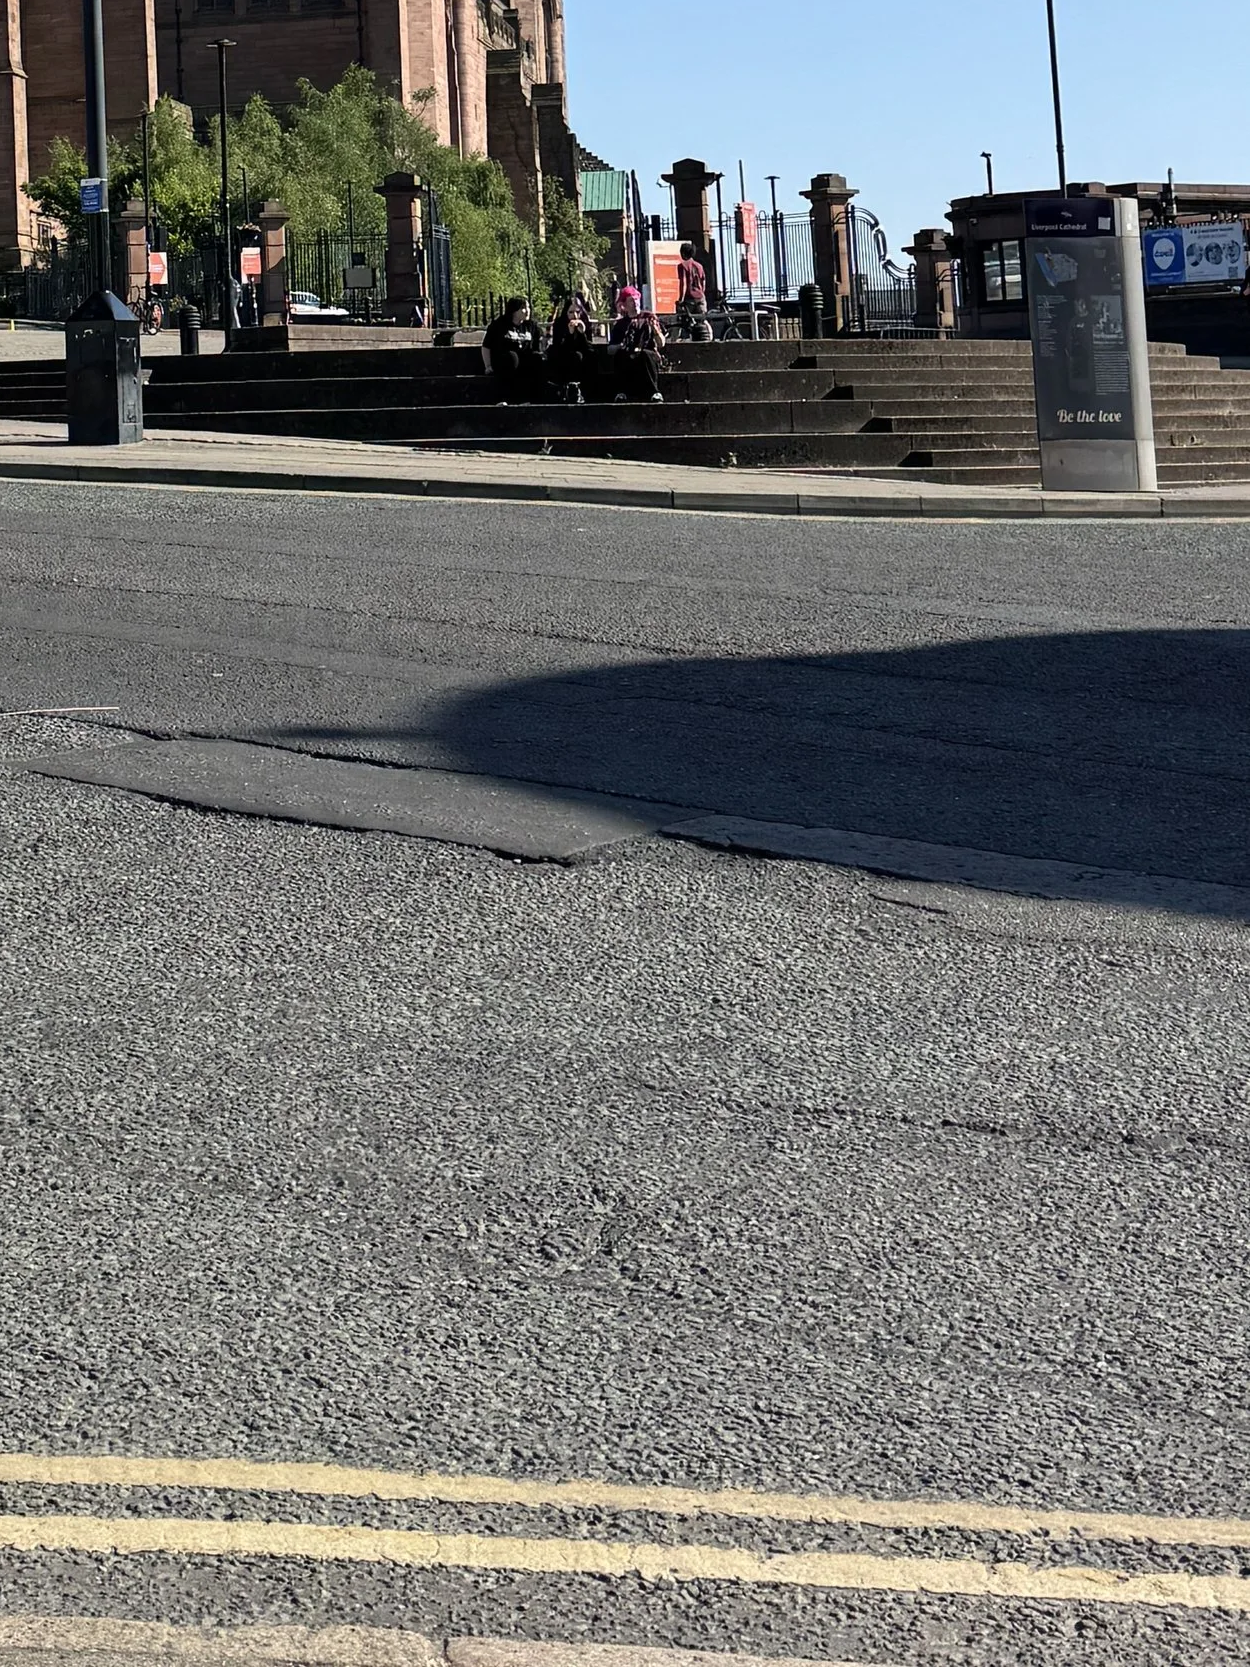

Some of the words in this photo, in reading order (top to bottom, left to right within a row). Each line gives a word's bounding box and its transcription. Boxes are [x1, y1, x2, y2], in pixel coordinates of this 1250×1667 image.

[1031, 223, 1058, 231] Liverpool
[1056, 409, 1074, 422] Be
[1076, 409, 1096, 422] the
[1098, 409, 1122, 422] love
